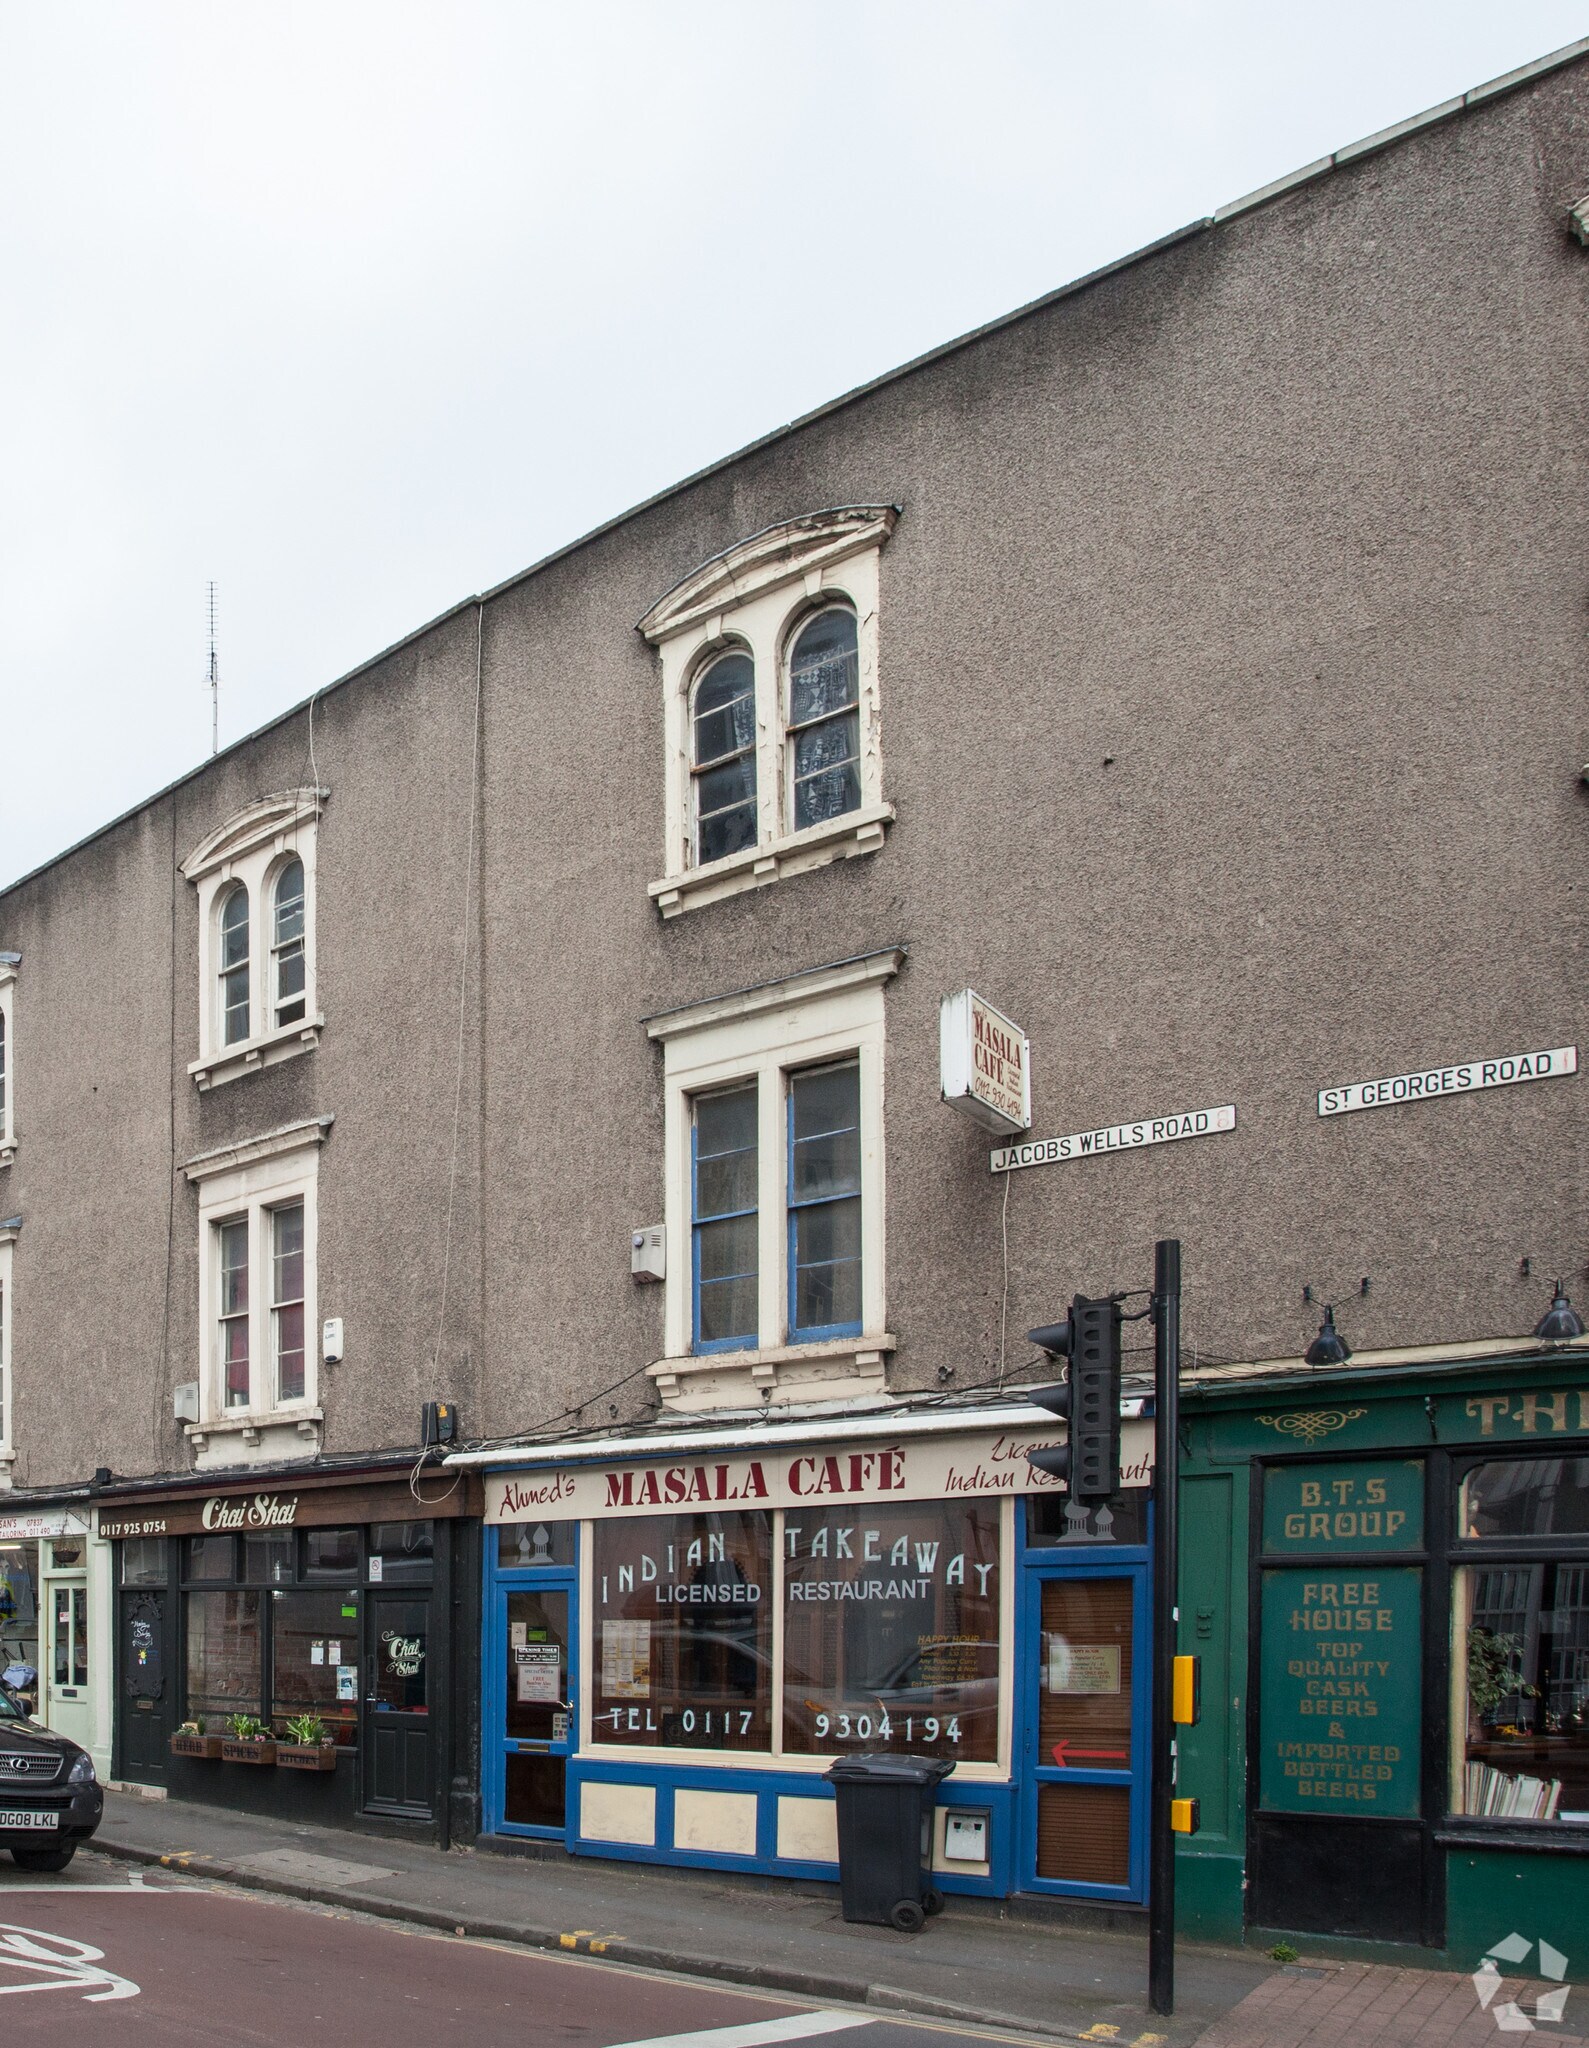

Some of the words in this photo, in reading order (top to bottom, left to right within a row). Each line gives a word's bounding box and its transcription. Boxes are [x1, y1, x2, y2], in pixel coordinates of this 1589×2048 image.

[974, 1015, 1022, 1070] MASALA
[1361, 1067, 1472, 1105] GEORGES
[1482, 1053, 1551, 1084] ROAD
[974, 1077, 990, 1098] 0117
[992, 1087, 1005, 1108] 930
[1007, 1097, 1021, 1117] 4194
[995, 1139, 1071, 1169] JACOBS
[1080, 1125, 1144, 1153] WELLS
[1152, 1113, 1208, 1140] ROAD
[1465, 1391, 1589, 1435] TH
[499, 1472, 576, 1517] Ahmed's
[605, 1462, 769, 1507] MASALA
[788, 1446, 906, 1496] CAFÉ
[945, 1465, 1015, 1492] Indian
[202, 1497, 247, 1530] Chai
[247, 1494, 298, 1526] Shai
[100, 1524, 121, 1536] 0117
[124, 1522, 140, 1535] 925
[143, 1520, 167, 1533] 0754
[1284, 1510, 1406, 1540] GROUP
[602, 1533, 725, 1603] INDIAN
[785, 1527, 994, 1597] TAKEAWAY
[656, 1584, 761, 1603] LICENSED
[789, 1578, 931, 1601] RESTAURANT
[1303, 1583, 1380, 1608] FREE
[1289, 1610, 1393, 1632] HOUSE
[390, 1636, 420, 1659] Chai
[918, 1635, 949, 1645] HAPPY
[952, 1635, 980, 1643] HOUR
[1316, 1642, 1363, 1659] TOP
[396, 1661, 419, 1677] Shai
[1287, 1660, 1390, 1678] QUALITY
[1306, 1680, 1370, 1697] CASK
[1299, 1699, 1379, 1717] BEERS
[610, 1707, 657, 1731] TEL
[682, 1709, 752, 1735] 0117
[814, 1713, 962, 1743] 9304194
[1328, 1721, 1345, 1739] &
[223, 1744, 259, 1759] SPICES
[1278, 1742, 1401, 1762] IMPORTED
[1284, 1761, 1393, 1780] BOTTLED
[1298, 1781, 1377, 1800] BEERS
[0, 1812, 31, 1826] DG08
[34, 1813, 57, 1827] LKL
